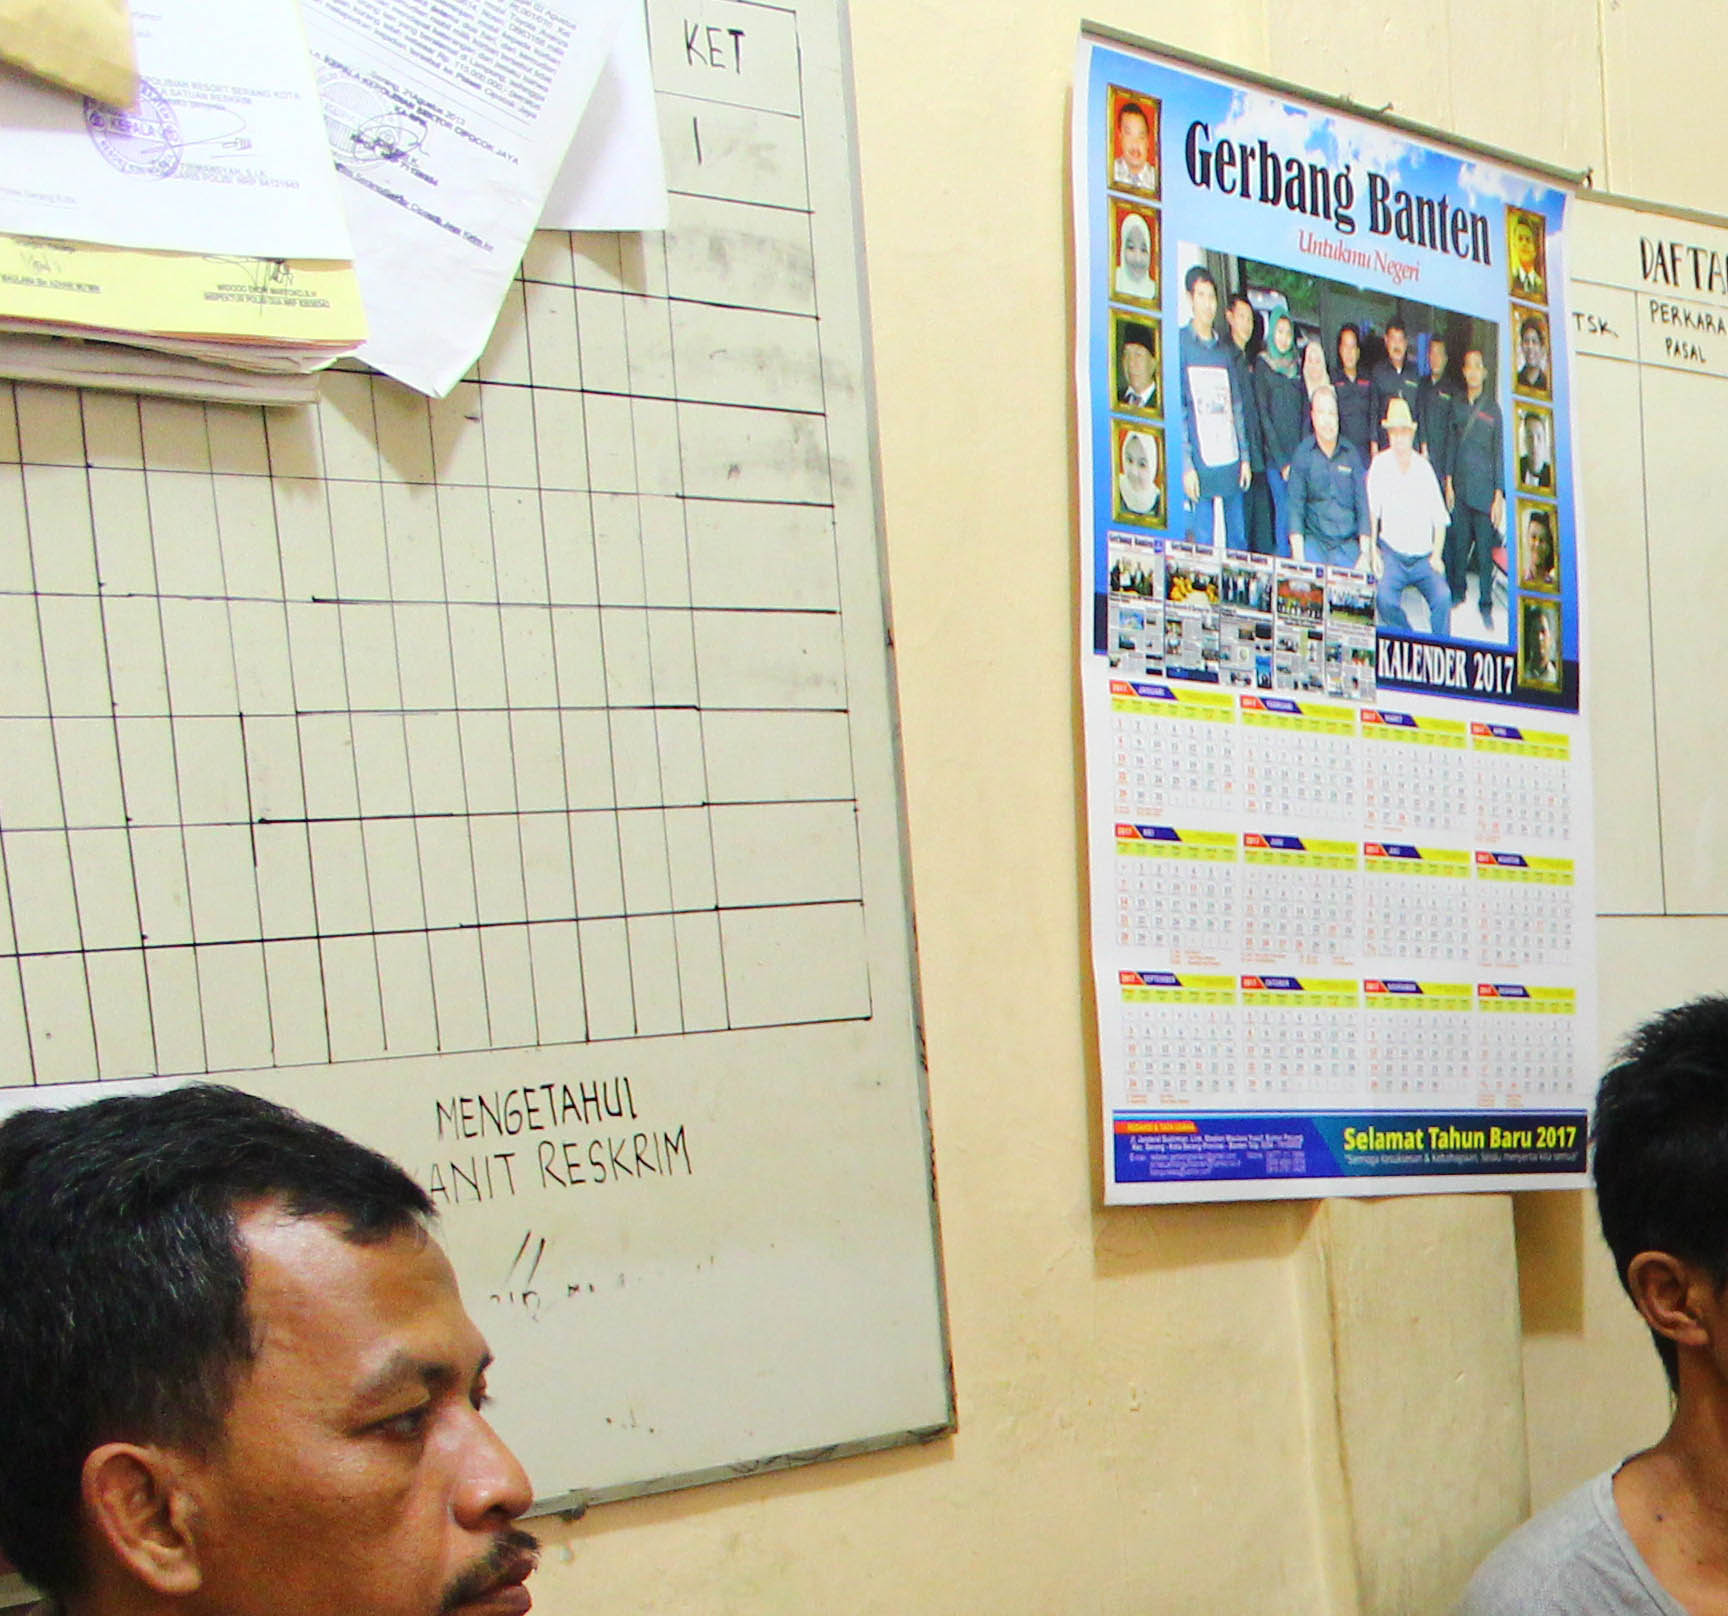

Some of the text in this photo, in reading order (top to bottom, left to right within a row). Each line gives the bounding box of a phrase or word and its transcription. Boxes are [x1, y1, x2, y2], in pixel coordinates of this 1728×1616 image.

[685, 20, 744, 75] KET
[1185, 120, 1492, 265] Gerbang Banten
[1298, 229, 1420, 286] Untukmu Negeri
[1666, 337, 1706, 364] PASAL
[1377, 638, 1514, 694] KALENDER 2017
[436, 1076, 637, 1141] MENGETAHUI
[428, 1124, 692, 1204] ANIT RESKRIM
[1343, 1125, 1577, 1150] Selamat Tahun Baru 2017
